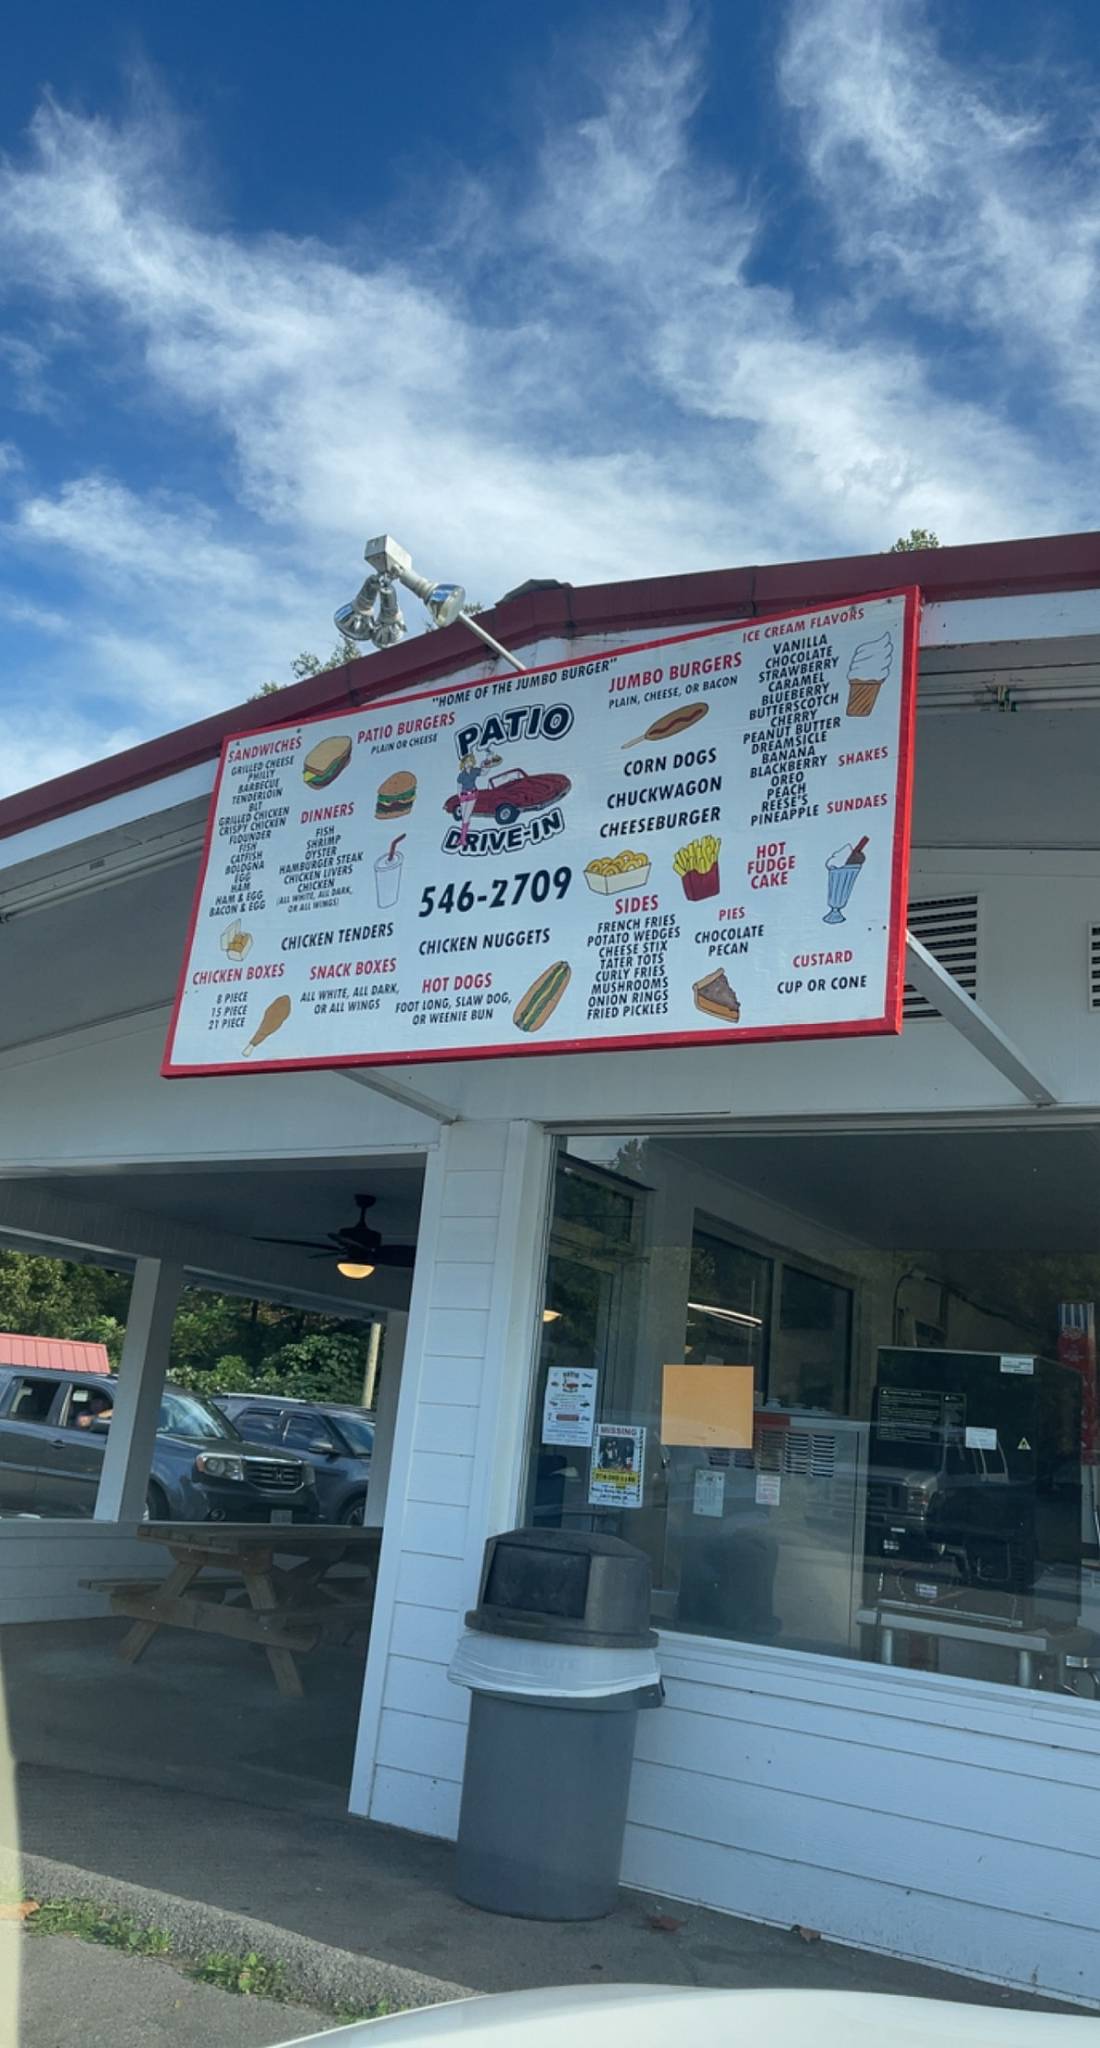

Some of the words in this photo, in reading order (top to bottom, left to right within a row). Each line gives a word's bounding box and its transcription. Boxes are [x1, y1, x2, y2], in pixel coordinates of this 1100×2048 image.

[742, 630, 760, 643] ICE
[764, 621, 806, 638] CREAM
[810, 608, 864, 629] FLAVORS
[773, 634, 828, 654] VANILLA
[765, 646, 832, 669] CHOCOLATE
[608, 669, 663, 693] JUMBO
[670, 652, 742, 680] BURGERS
[758, 656, 840, 683] STRAWBERRY
[432, 690, 470, 708] "HOME
[474, 688, 488, 699] OF
[492, 682, 513, 696] THE
[515, 673, 557, 690] JUMBO
[560, 658, 618, 681] BURGER"
[768, 672, 824, 692] CARAMEL
[608, 695, 640, 708] PLAIN,
[644, 687, 682, 702] CHEESE,
[686, 683, 700, 694] OR
[703, 676, 738, 690] BACON
[762, 682, 830, 706] BLUEBERRY
[750, 692, 838, 720] BUTTERSCOTCH
[770, 708, 818, 728] CHERRY
[357, 725, 392, 744] PATIO
[398, 712, 456, 736] BURGERS
[456, 704, 572, 757] PATIO
[743, 726, 790, 744] PEANUT
[796, 717, 840, 734] BUTTER
[228, 736, 302, 763] SANDWICHES
[371, 743, 394, 755] PLAIN
[396, 740, 408, 750] OR
[409, 734, 438, 748] CHEESE
[752, 730, 828, 754] DREAMSICLE
[624, 756, 667, 776] CORN
[672, 748, 716, 769] DOGS
[762, 746, 816, 764] BANANA
[838, 746, 888, 767] SHAKES
[231, 763, 262, 776] GRILLED
[266, 756, 294, 768] CHEESE
[248, 770, 275, 781] PHILLY
[750, 754, 828, 778] BLACKBERRY
[238, 779, 280, 794] BARBECUE
[771, 771, 804, 786] OREO
[232, 788, 283, 804] TENDERLOIN
[607, 776, 722, 809] CHUCKWAGON
[768, 783, 806, 800] PEACH
[249, 802, 262, 812] BLT
[762, 794, 808, 812] REESE'S
[827, 794, 888, 814] SUNDAES
[219, 814, 252, 826] GRILLED
[254, 806, 290, 820] CHICKEN
[300, 802, 354, 824] DINNERS
[600, 806, 720, 838] CHEESEBURGER
[750, 804, 819, 826] PINEAPPLE
[219, 824, 248, 836] CRISPY
[250, 818, 286, 830] CHICKEN
[316, 826, 335, 838] FISH
[443, 809, 563, 854] DRIVE-IN
[230, 830, 272, 845] FLOUNDER
[306, 834, 342, 850] SHRIMP
[230, 850, 262, 864] CATFISH
[239, 842, 257, 853] FISH
[305, 846, 338, 860] OYSTER
[756, 842, 786, 858] HOT
[225, 860, 264, 875] BOLOGNA
[279, 858, 334, 875] HAMBURGER
[336, 852, 364, 865] STEAK
[747, 856, 796, 874] FUDGE
[234, 872, 251, 883] EGG
[284, 870, 320, 884] CHICKEN
[324, 864, 353, 878] LIVERS
[751, 872, 788, 890] CAKE
[231, 882, 250, 892] HAM
[292, 892, 316, 902] WHITE,
[318, 890, 330, 898] ALL
[332, 886, 352, 896] DARK,
[298, 879, 335, 892] CHICKEN
[418, 866, 572, 918] 546-2709
[216, 894, 236, 905] HAM
[238, 893, 244, 902] &
[247, 890, 263, 901] EGG
[616, 894, 658, 914] SIDES
[209, 904, 238, 917] BACON
[240, 904, 246, 912] &
[248, 900, 266, 911] EGG
[288, 904, 298, 913] OR
[300, 902, 310, 911] ALL
[719, 907, 745, 920] PIES
[598, 918, 640, 933] FRENCH
[645, 914, 676, 928] FRIES
[281, 930, 334, 951] CHICKEN
[338, 922, 394, 943] TENDERS
[418, 936, 478, 956] CHICKEN
[482, 928, 550, 948] NUGGETS
[588, 932, 629, 947] POTATO
[634, 926, 680, 942] WEDGES
[695, 924, 764, 944] CHOCOLATE
[599, 944, 638, 958] CHEESE
[643, 940, 668, 954] STIX
[708, 942, 748, 956] PECAN
[600, 956, 632, 970] TATER
[638, 953, 664, 966] TOTS
[793, 950, 852, 968] CUSTARD
[193, 968, 242, 985] CHICKEN
[246, 963, 285, 980] BOXES
[310, 963, 352, 980] SNACK
[355, 958, 396, 975] BOXES
[596, 968, 630, 982] CURLY
[634, 965, 665, 978] FRIES
[300, 992, 315, 1002] ALL
[318, 988, 350, 1000] WHITE,
[353, 986, 368, 997] ALL
[371, 983, 399, 996] DARK,
[422, 977, 448, 994] HOT
[454, 973, 492, 990] DOGS
[591, 977, 668, 994] MUSHROOMS
[777, 982, 802, 994] CUP
[808, 979, 825, 992] OR
[831, 976, 867, 990] CONE
[217, 994, 222, 1004] 8
[224, 992, 248, 1002] PIECE
[314, 1004, 326, 1014] OR
[329, 1002, 344, 1012] ALL
[348, 999, 380, 1012] WINGS
[396, 1001, 420, 1013] FOOT
[422, 998, 451, 1010] LONG,
[456, 995, 484, 1007] SLAW
[487, 992, 512, 1005] DOG,
[588, 993, 628, 1007] ONION
[632, 989, 668, 1002] RINGS
[212, 1008, 221, 1016] 15
[224, 1006, 248, 1016] PIECE
[412, 1014, 426, 1025] OR
[429, 1011, 466, 1024] WEENIE
[471, 1010, 493, 1020] BUN
[587, 1007, 619, 1020] FRIED
[623, 1002, 668, 1016] PICKLES
[208, 1020, 218, 1030] 21
[222, 1018, 245, 1028] PIECE
